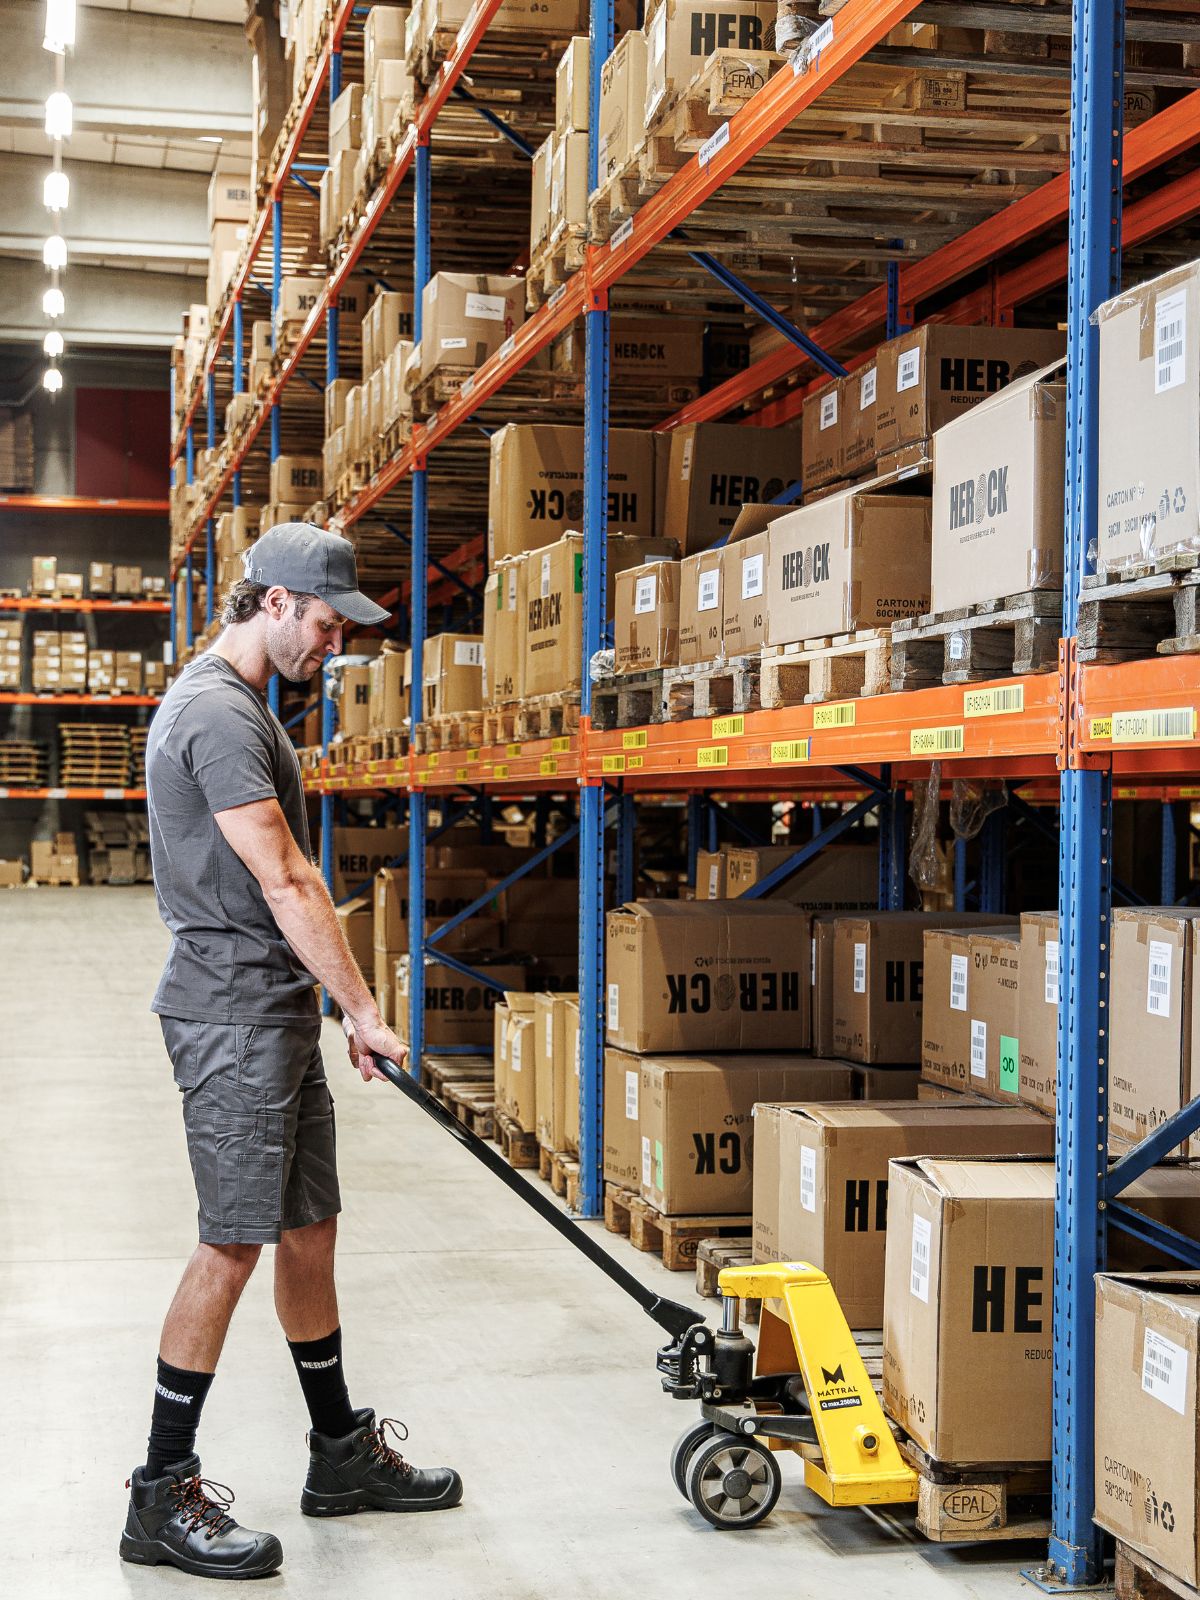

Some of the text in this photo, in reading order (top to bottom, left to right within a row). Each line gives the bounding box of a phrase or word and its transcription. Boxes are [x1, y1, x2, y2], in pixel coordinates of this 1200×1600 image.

[614, 343, 665, 360] HEROCK
[950, 465, 1008, 530] HEROCK
[1107, 489, 1128, 508] CARTON
[782, 543, 830, 591] HEROCK
[529, 592, 562, 632] HEROCK
[876, 599, 916, 609] CARTON
[666, 972, 799, 1014] HEROCK
[972, 1265, 1043, 1333] HE
[300, 1355, 339, 1370] HEROCK
[1024, 1349, 1053, 1360] REDUC
[817, 1386, 858, 1398] MATTRAL
[1104, 1456, 1132, 1483] CARTON
[952, 1495, 990, 1514] EPAL
